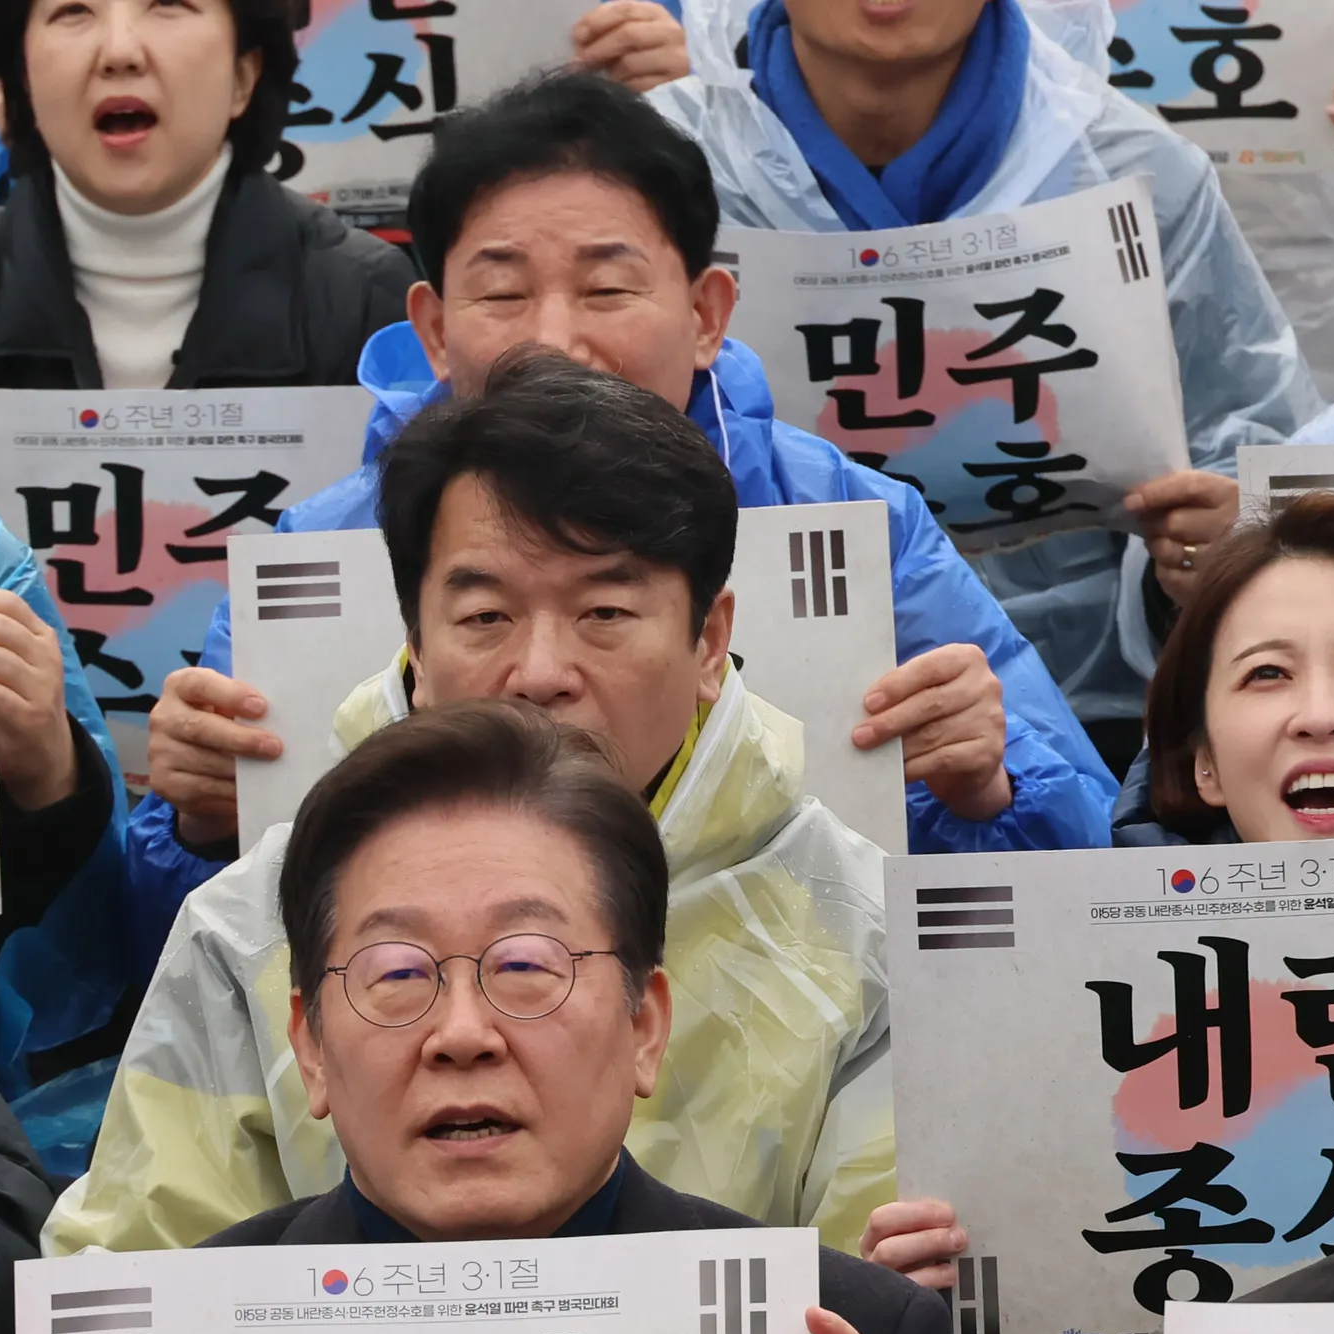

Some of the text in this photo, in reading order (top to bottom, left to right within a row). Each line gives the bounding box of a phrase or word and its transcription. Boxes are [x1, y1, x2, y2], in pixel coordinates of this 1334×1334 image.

[796, 287, 1099, 430] 민주
[1091, 906, 1120, 919] 야5당
[1123, 905, 1146, 918] 공동
[1278, 898, 1301, 911] 위한
[235, 1308, 266, 1323] 야5당
[269, 1307, 294, 1321] 공동
[437, 1302, 461, 1317] 위한
[465, 1302, 500, 1317] 윤석열
[504, 1300, 528, 1315] 파면
[531, 1299, 555, 1313] 촉구
[558, 1296, 619, 1312] 범국민대회
